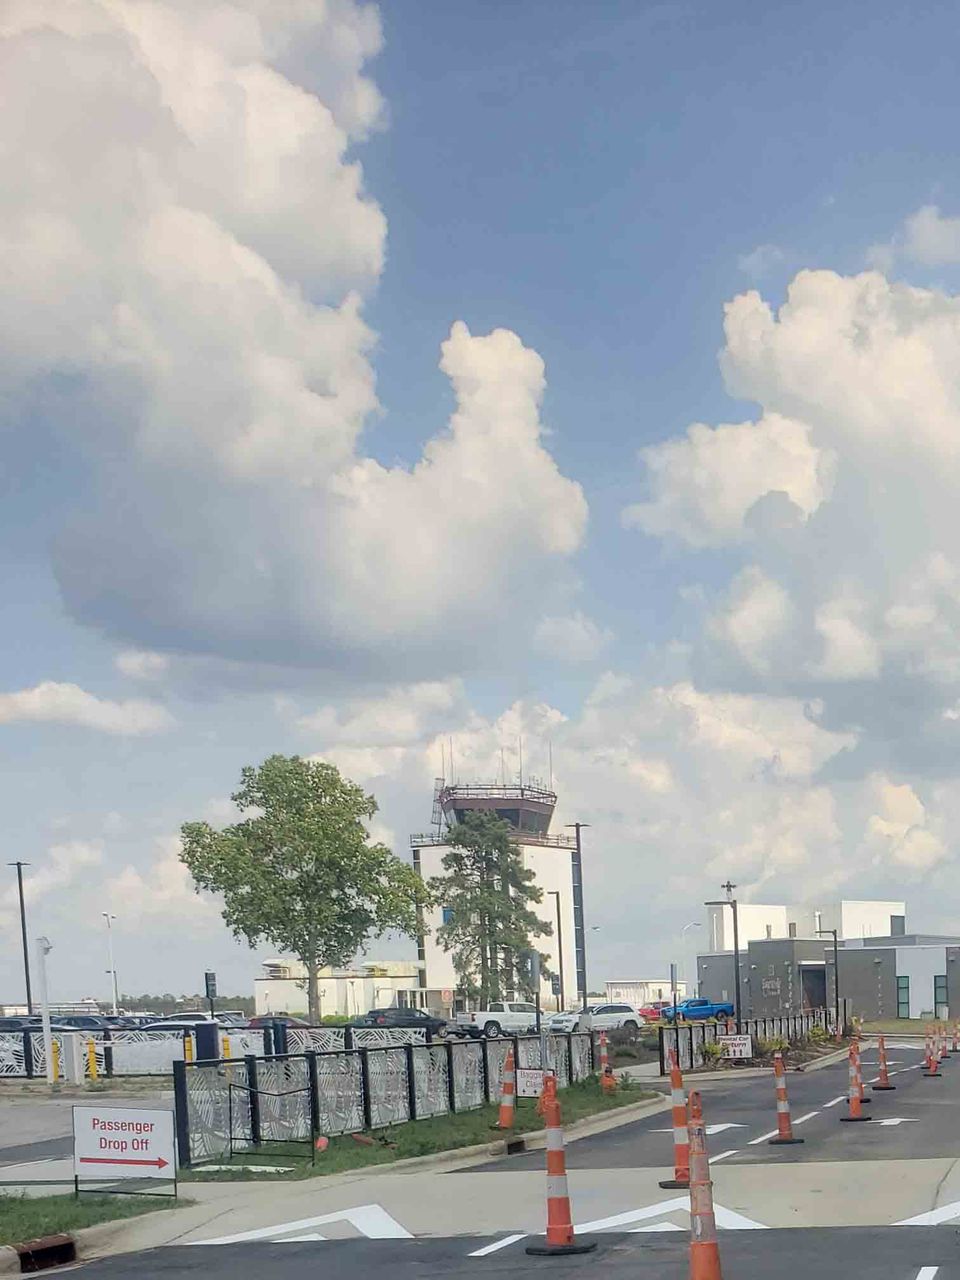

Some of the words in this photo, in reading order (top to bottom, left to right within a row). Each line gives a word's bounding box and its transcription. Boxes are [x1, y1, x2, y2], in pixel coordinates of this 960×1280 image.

[92, 1117, 155, 1134] Passenger
[99, 1137, 128, 1152] Drop
[131, 1138, 150, 1151] Off
